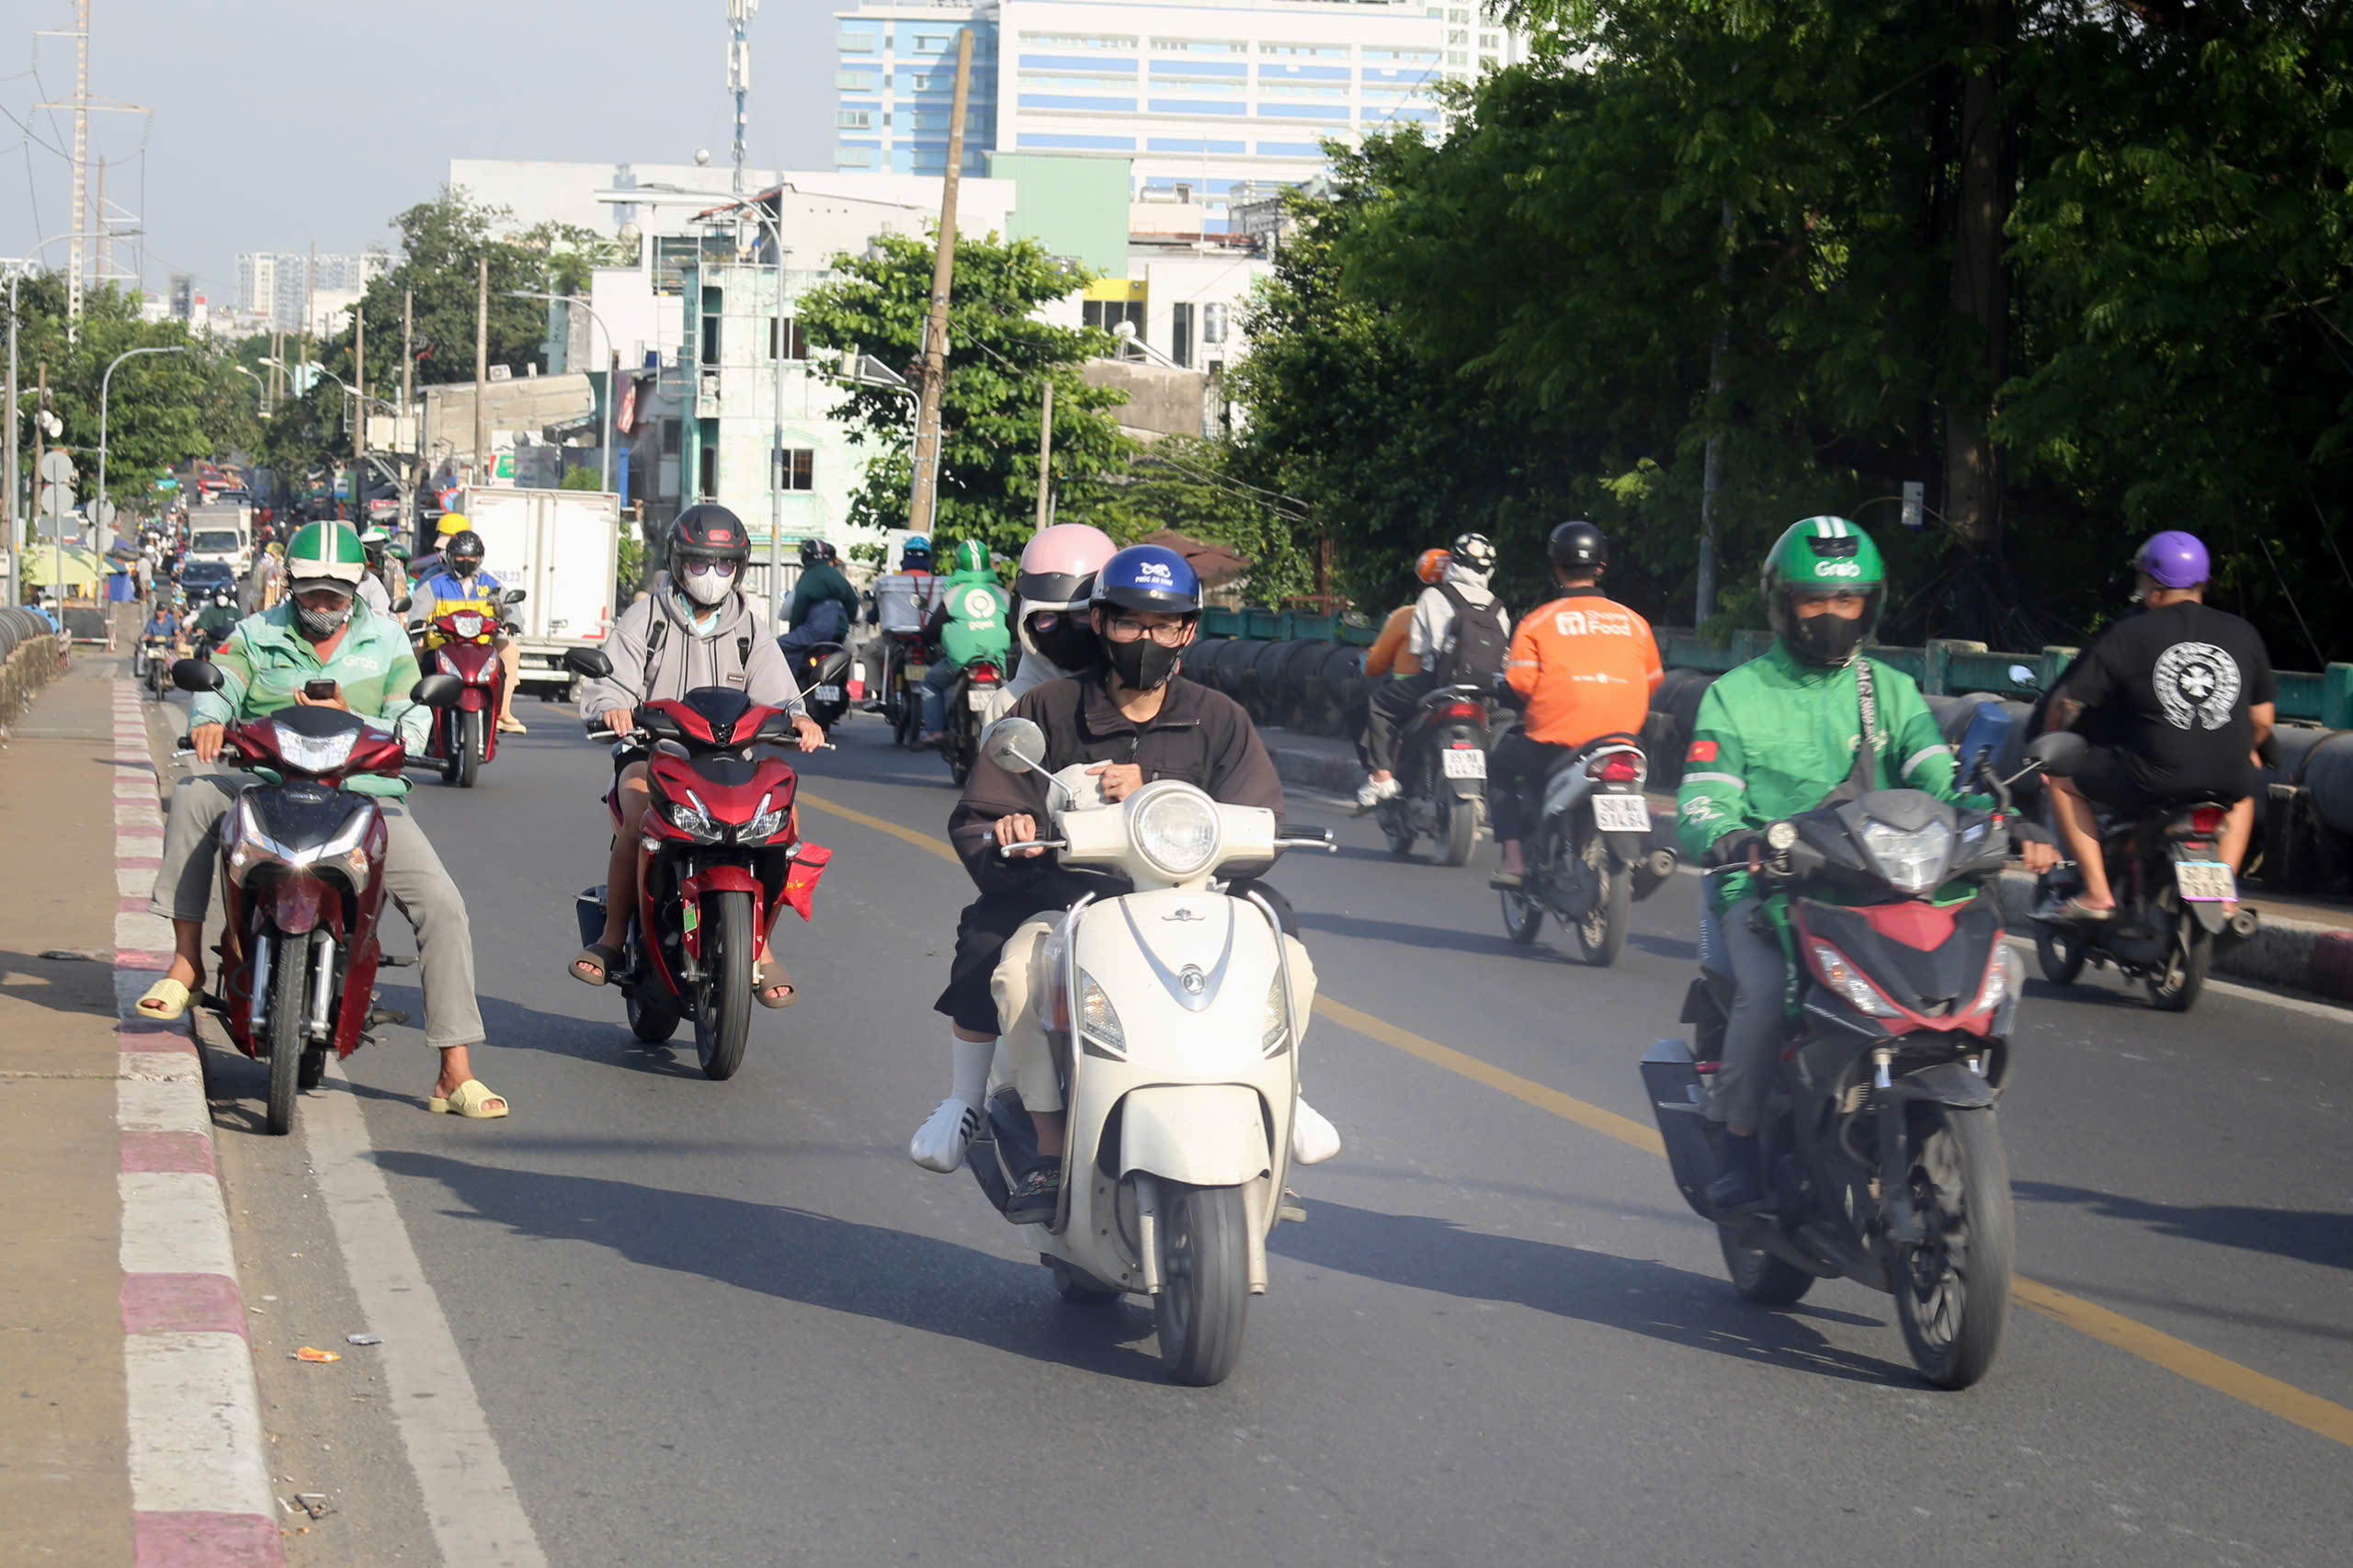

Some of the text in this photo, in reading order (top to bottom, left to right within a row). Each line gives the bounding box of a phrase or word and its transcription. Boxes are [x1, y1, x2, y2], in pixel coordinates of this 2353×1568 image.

[1814, 561, 1860, 577] Grab
[1588, 620, 1632, 637] Food
[341, 653, 379, 670] Grab
